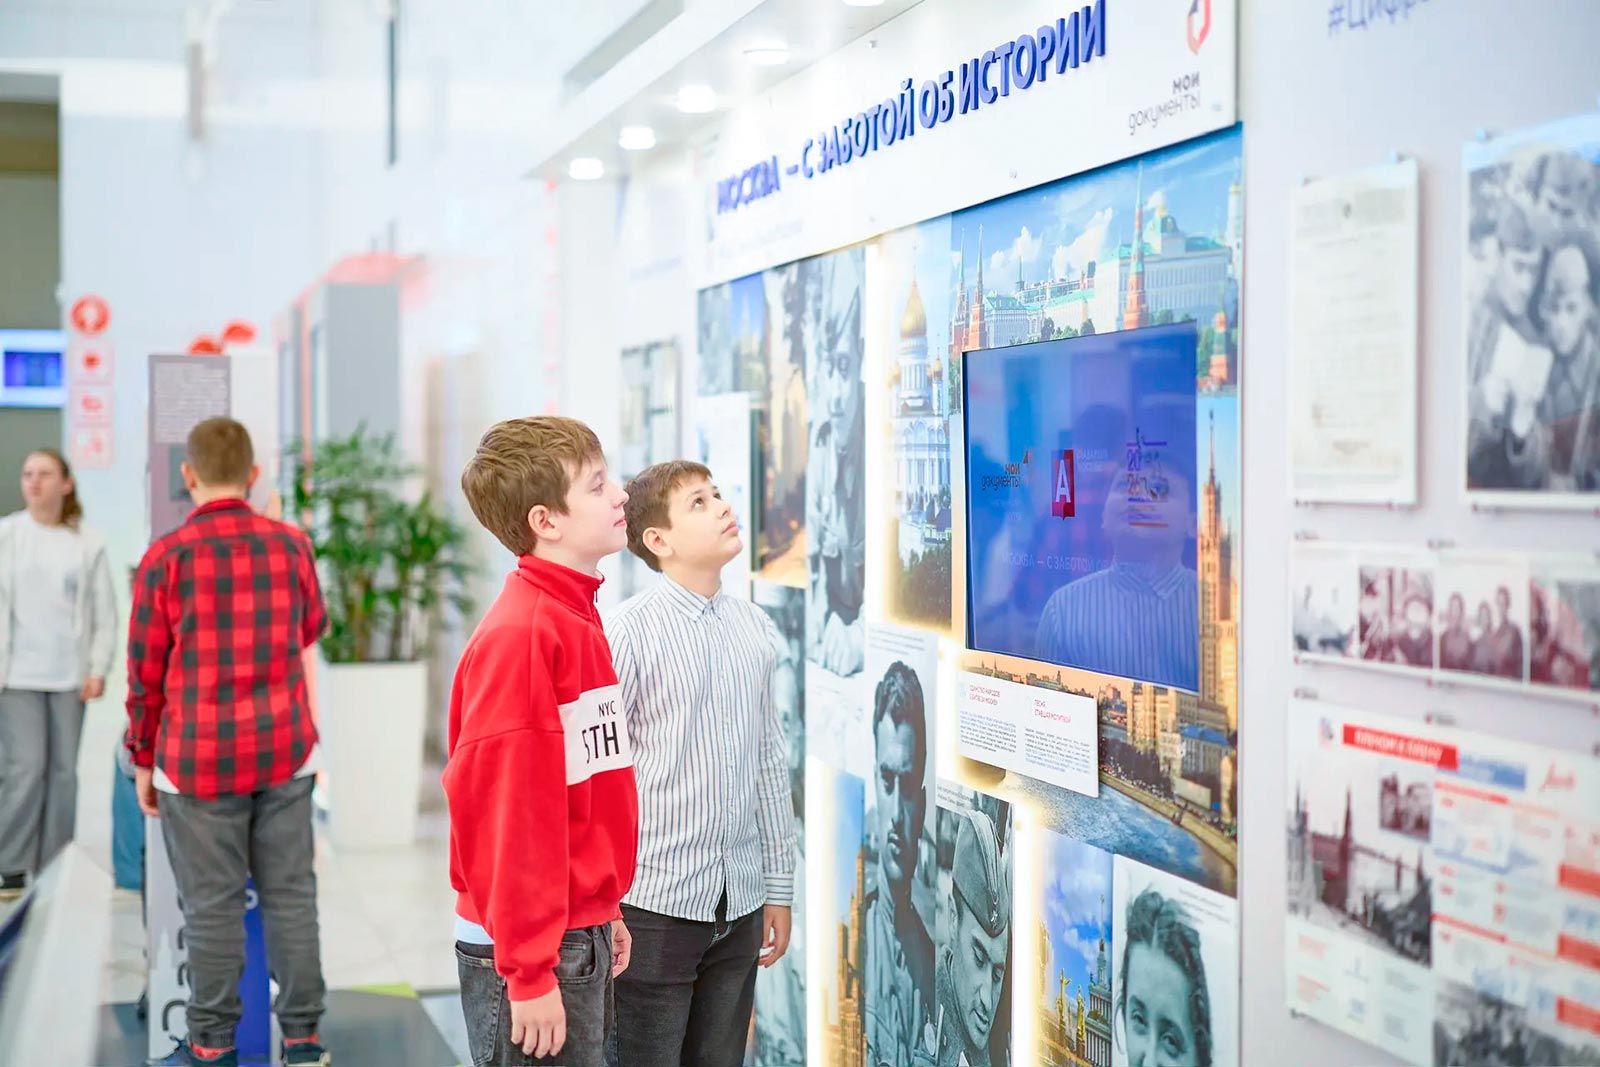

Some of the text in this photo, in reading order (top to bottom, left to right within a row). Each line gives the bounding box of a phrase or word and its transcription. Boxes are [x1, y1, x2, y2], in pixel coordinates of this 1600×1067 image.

[802, 138, 813, 178] С
[817, 78, 914, 173] ЗАБОТОЙ
[919, 71, 954, 129] ОБ
[959, 0, 1105, 114] ИСТОРИИ
[598, 700, 616, 717] NYC
